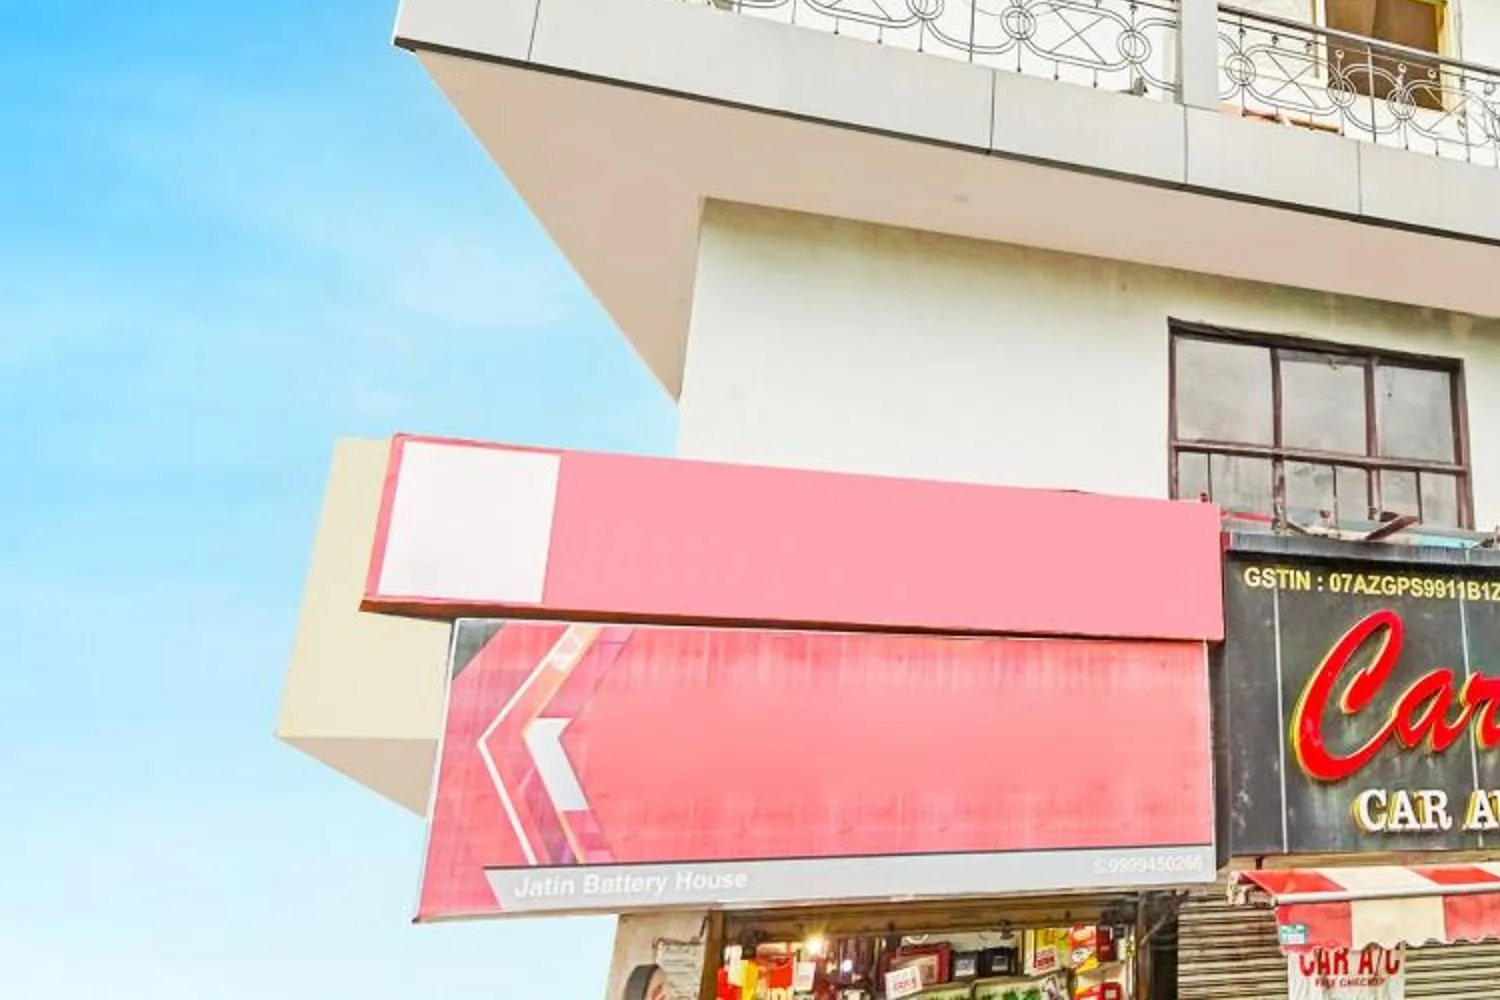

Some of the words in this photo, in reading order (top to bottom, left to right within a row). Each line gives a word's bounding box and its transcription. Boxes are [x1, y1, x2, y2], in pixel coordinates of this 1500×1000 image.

[1244, 567, 1311, 591] GSTIN
[1352, 787, 1452, 833] CAR
[514, 876, 575, 898] Jatin
[583, 873, 668, 895] Battery
[675, 871, 748, 891] House
[1299, 947, 1349, 977] CAR
